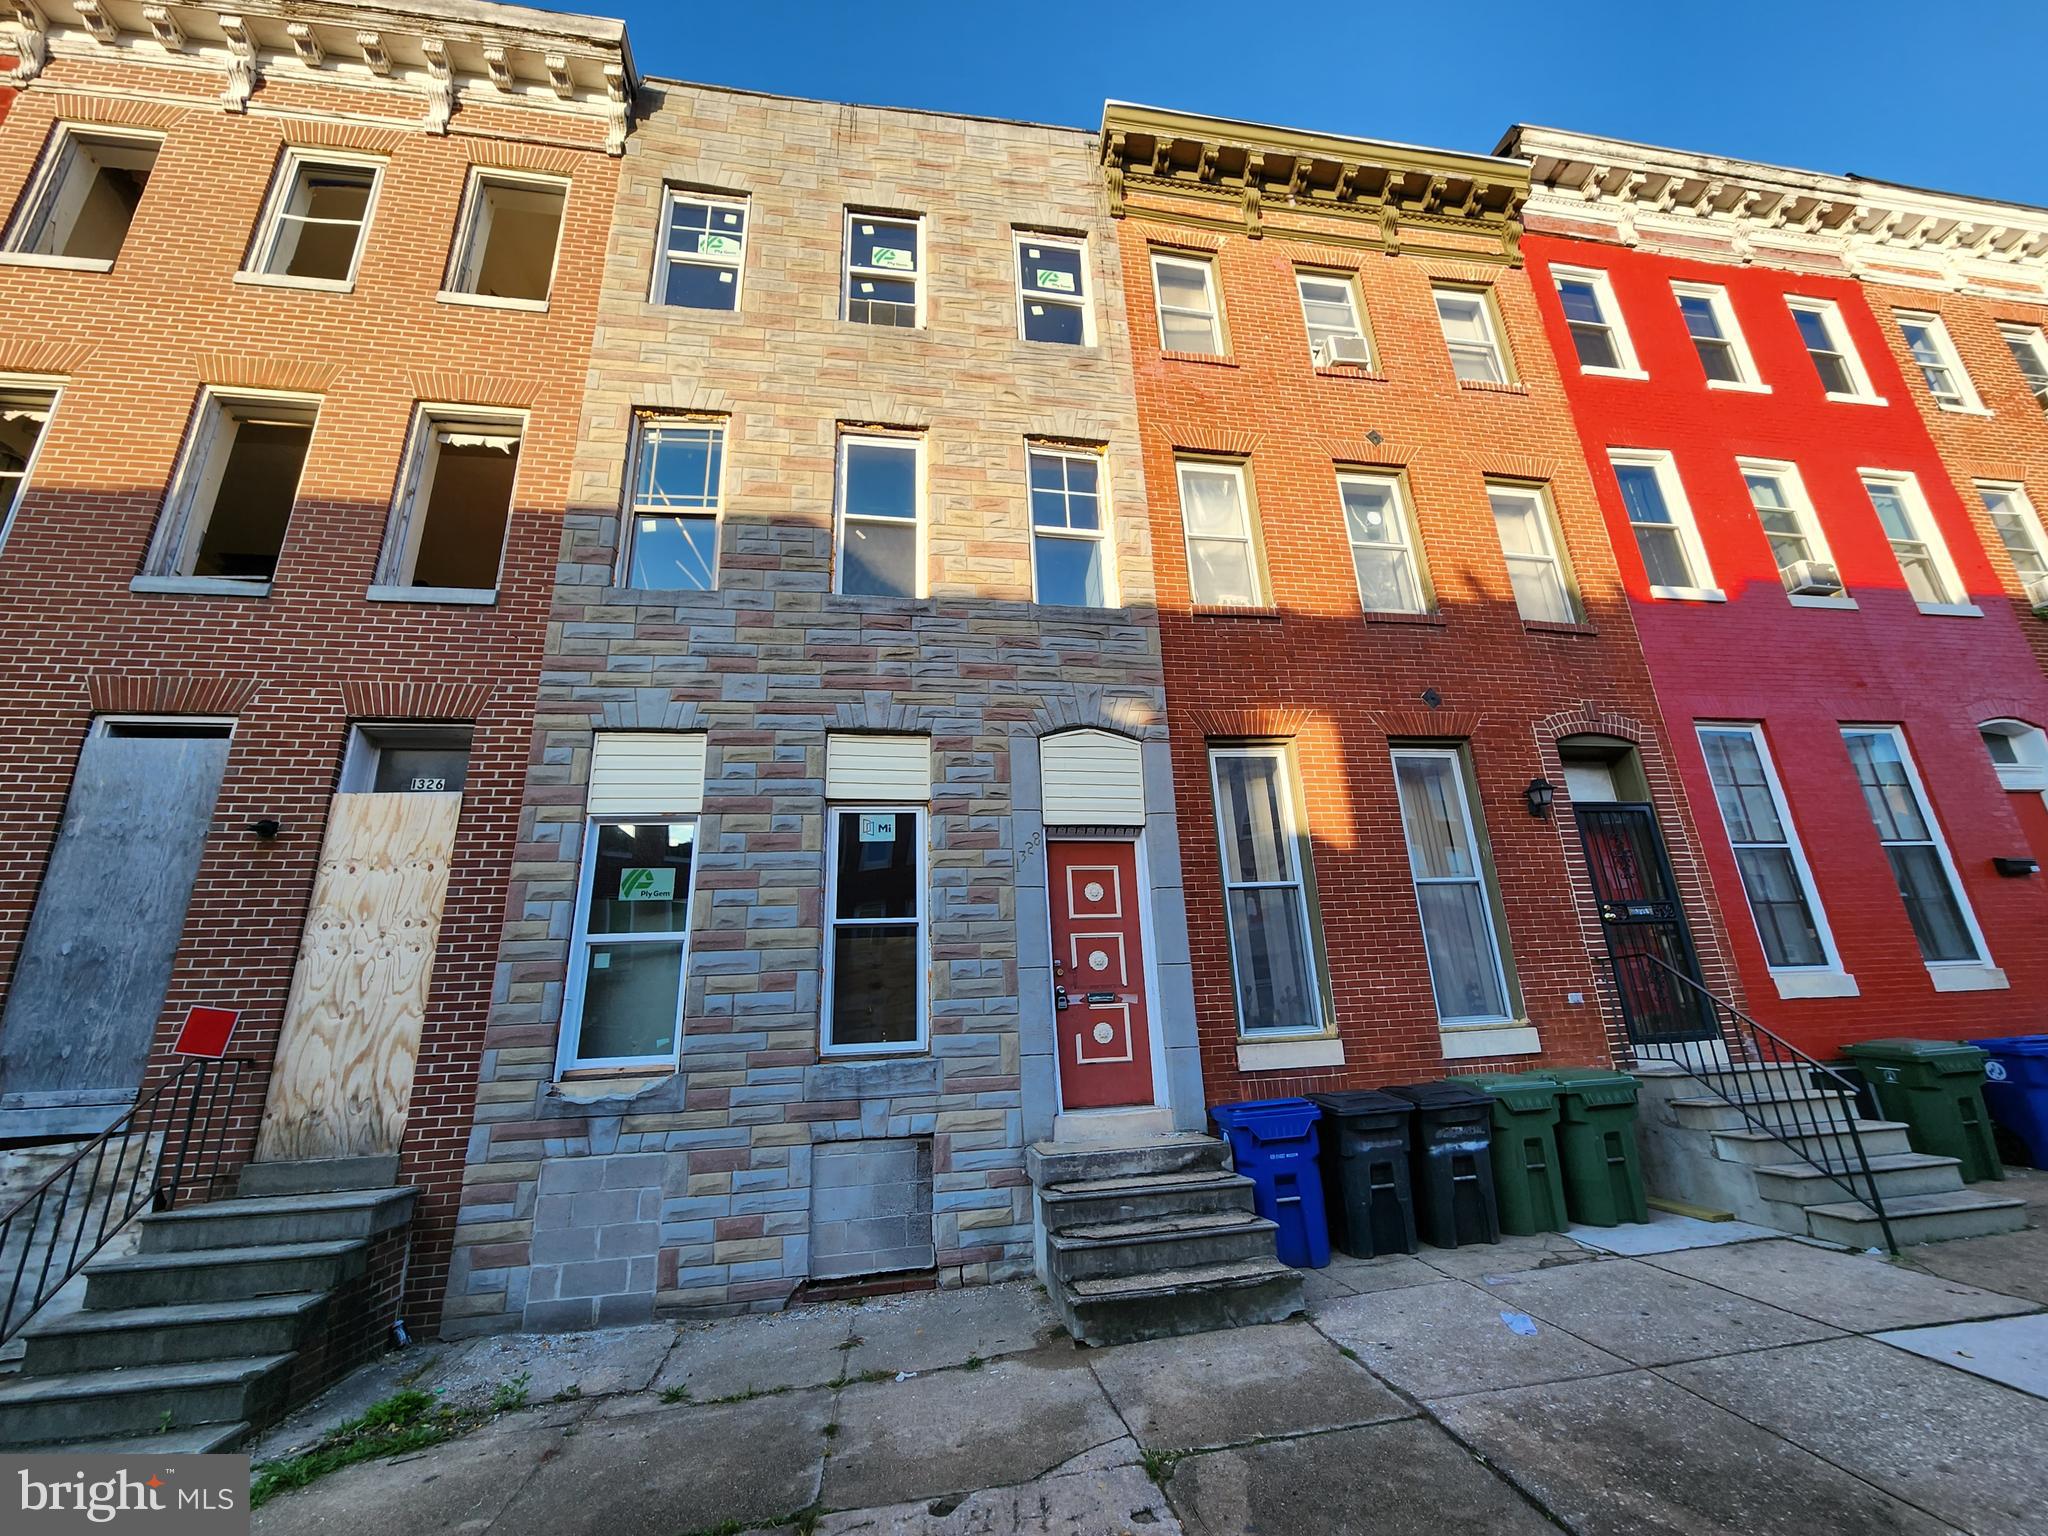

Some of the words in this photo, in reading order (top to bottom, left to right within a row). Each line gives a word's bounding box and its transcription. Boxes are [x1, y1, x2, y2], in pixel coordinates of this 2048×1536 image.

[412, 779, 443, 790] 1326
[878, 823, 892, 833] Mi
[640, 890, 653, 899] Ply
